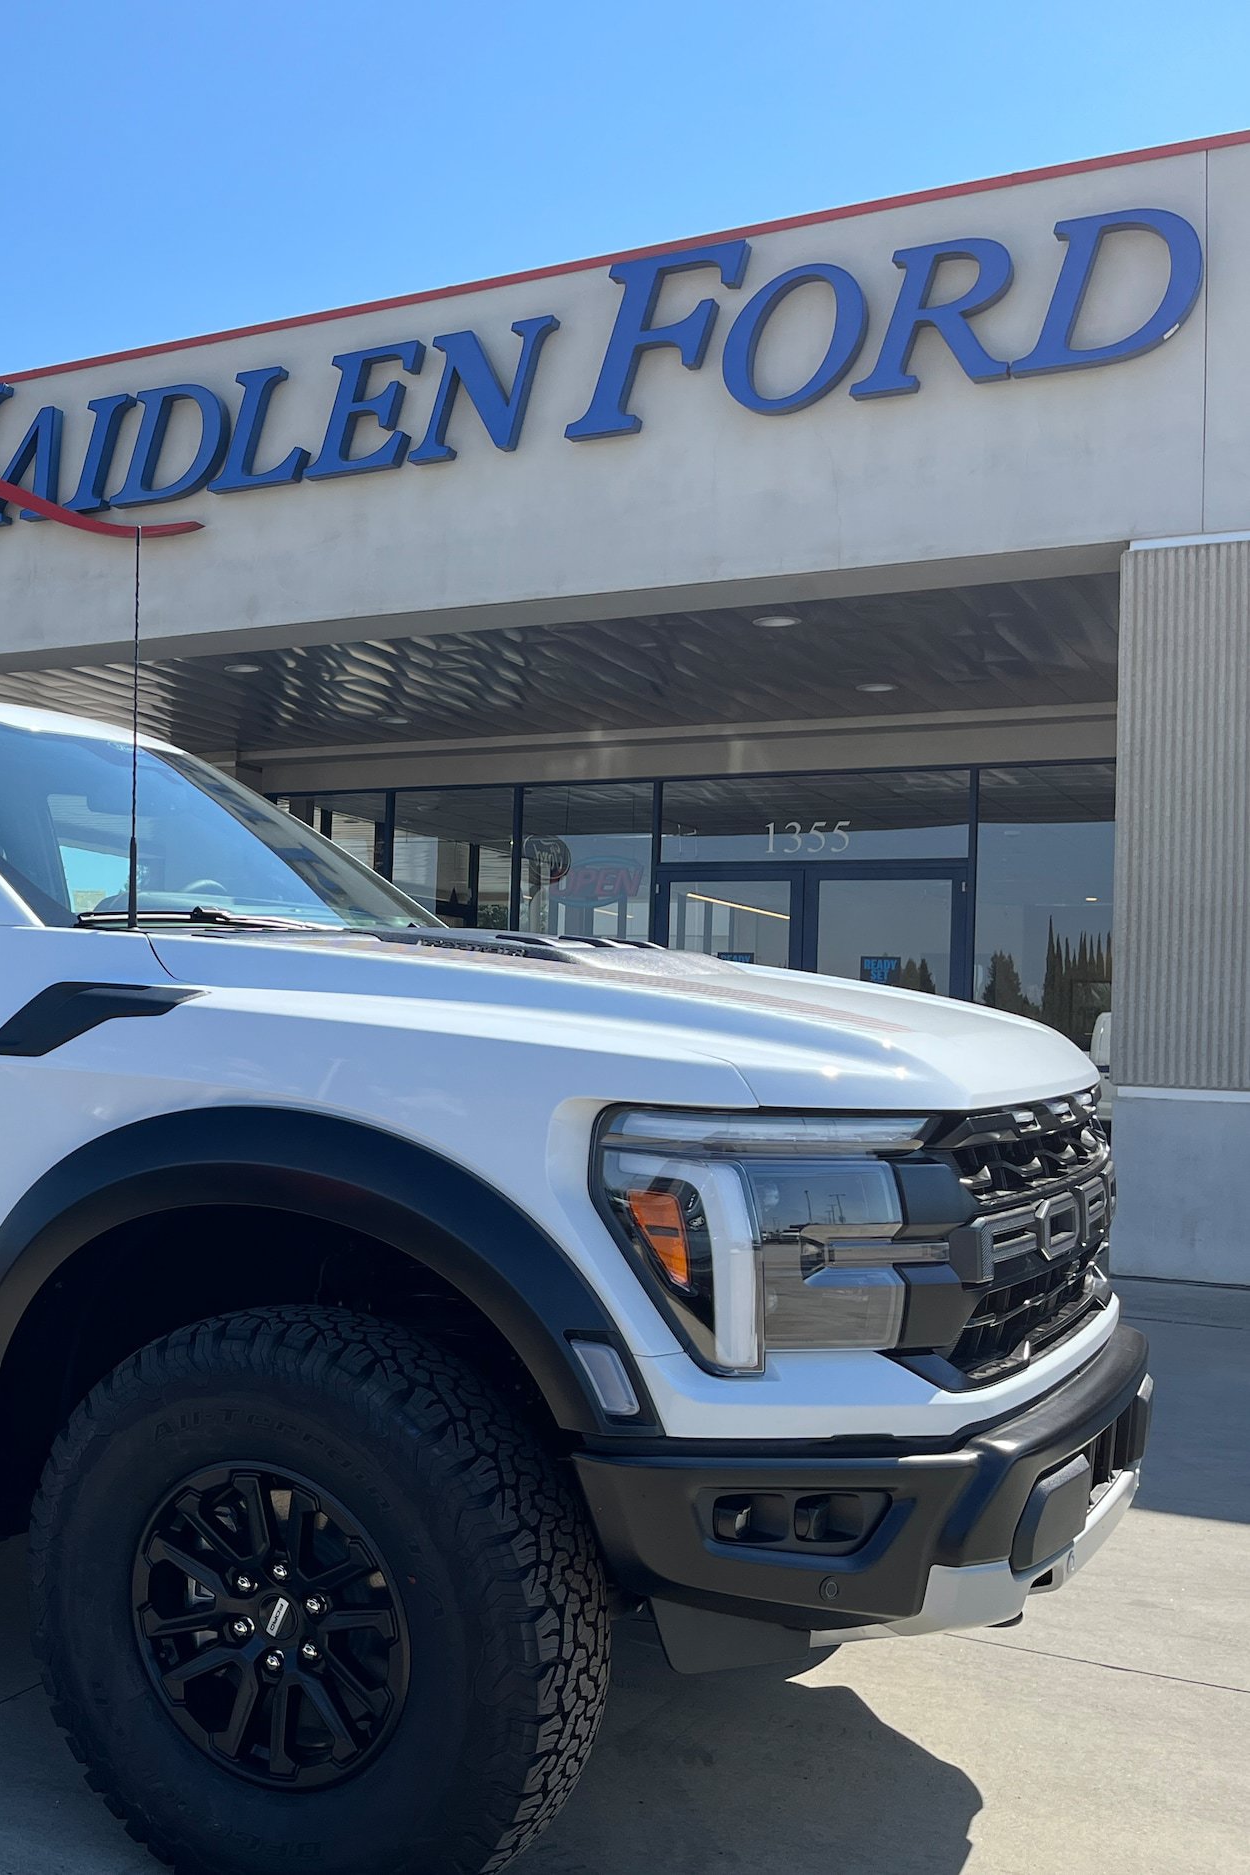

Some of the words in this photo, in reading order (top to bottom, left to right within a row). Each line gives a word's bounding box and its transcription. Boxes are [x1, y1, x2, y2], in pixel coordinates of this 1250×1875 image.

[565, 206, 1204, 442] FORD
[764, 820, 850, 853] 1355
[864, 959, 897, 970] READY
[871, 970, 888, 981] SET
[980, 1161, 1118, 1280] FORD
